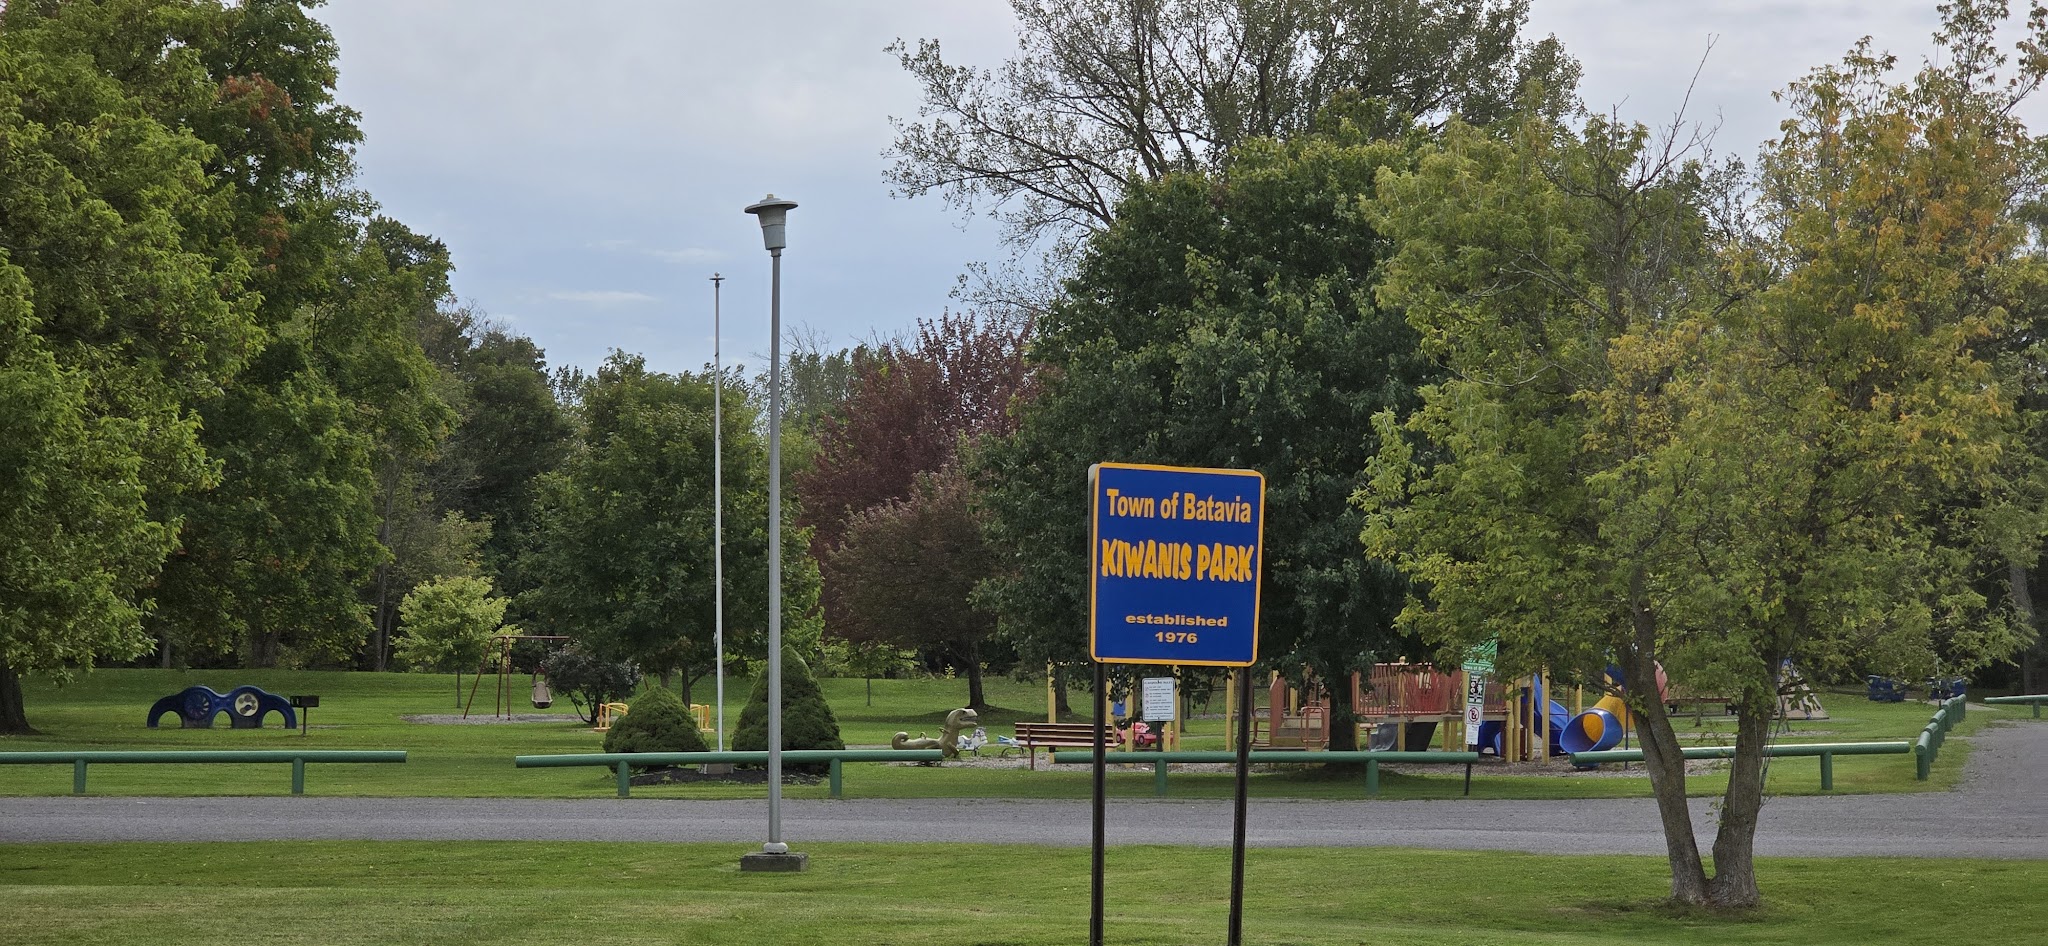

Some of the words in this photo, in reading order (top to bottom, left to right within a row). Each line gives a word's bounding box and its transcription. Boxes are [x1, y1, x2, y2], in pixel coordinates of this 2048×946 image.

[1106, 488, 1154, 518] Town
[1160, 492, 1179, 519] of
[1183, 492, 1252, 523] Batavia
[1101, 538, 1193, 580] KIWANIS
[1196, 542, 1254, 582] PARK
[1125, 614, 1228, 627] established
[1155, 632, 1198, 643] 1976
